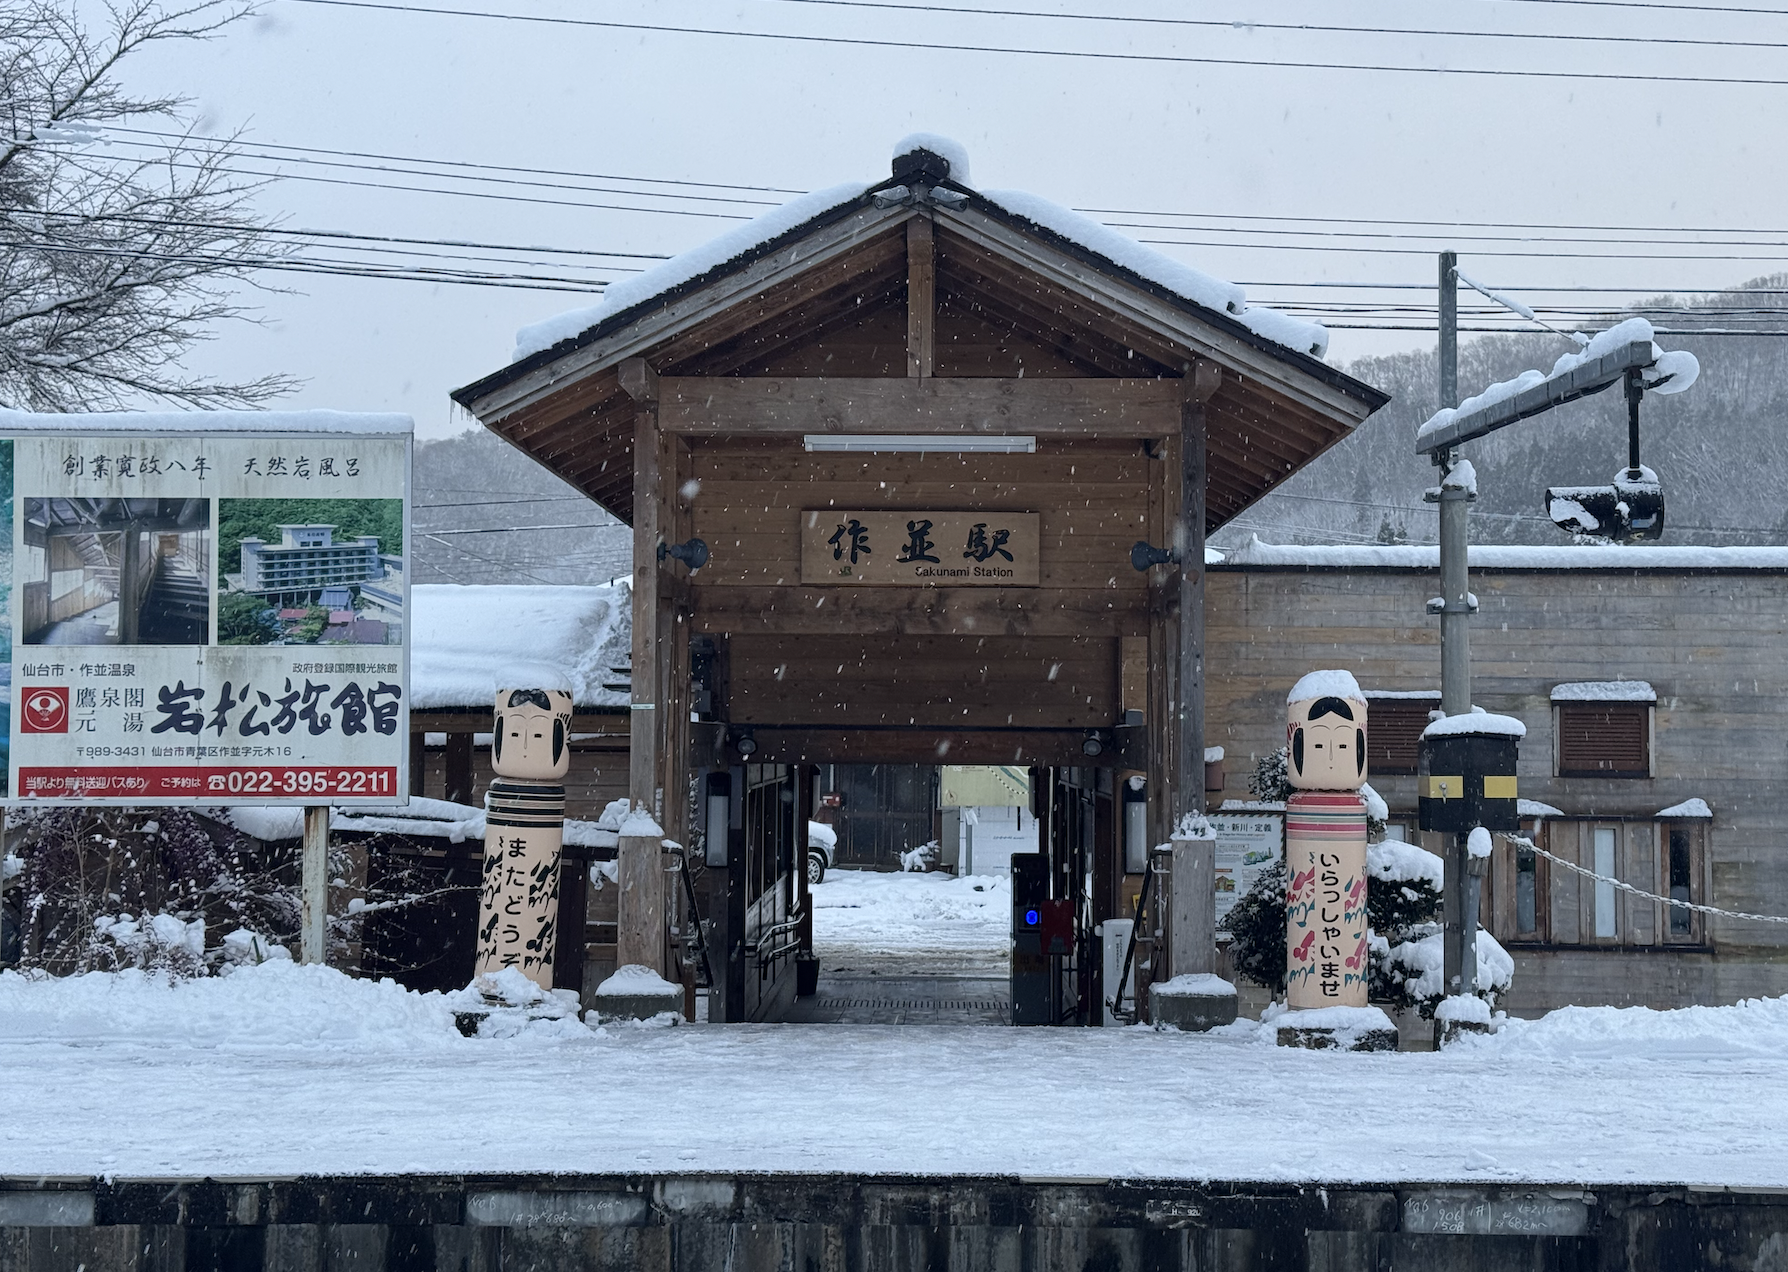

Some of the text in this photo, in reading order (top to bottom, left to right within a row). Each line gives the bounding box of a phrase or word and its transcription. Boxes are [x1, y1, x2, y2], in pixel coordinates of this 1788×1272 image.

[243, 455, 361, 478] 天然岩風呂
[827, 519, 1014, 565] 作並駅
[915, 566, 1014, 577] Sakunami Station
[22, 663, 136, 677] 仙台市・作並温泉
[292, 662, 398, 674] 政府登録国際観光旅館
[75, 687, 145, 708] 鷹泉閣
[150, 677, 402, 737] 岩松旅館
[151, 746, 292, 757] 仙台市青葉区作並字元木16
[25, 771, 389, 793] 当駅より無料送迎バスあり ご予約は 022-395-2211
[500, 837, 527, 968] またどうぞ
